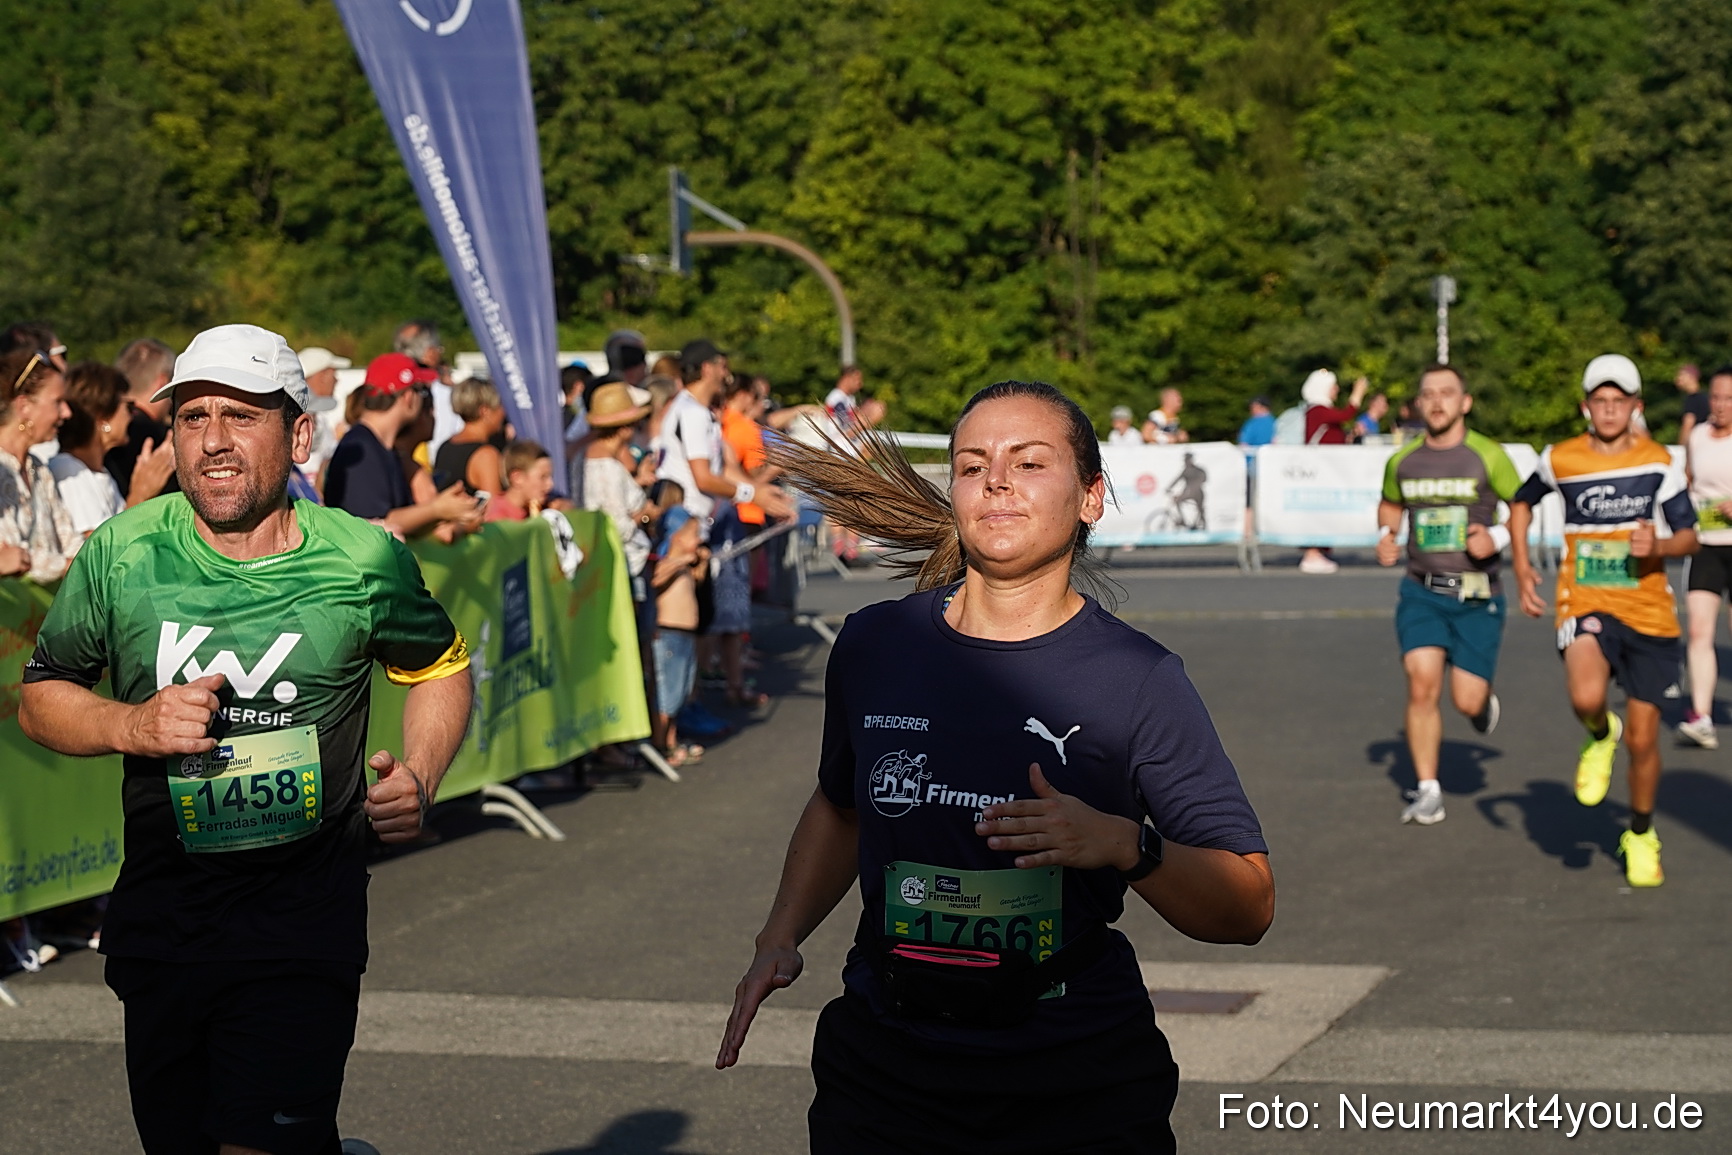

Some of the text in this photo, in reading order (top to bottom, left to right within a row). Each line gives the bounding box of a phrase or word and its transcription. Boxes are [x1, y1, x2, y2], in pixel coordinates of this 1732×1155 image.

[213, 706, 293, 727] NERGIE
[871, 715, 930, 732] PFLEIDERER
[206, 755, 252, 772] Firmenlauf
[225, 764, 253, 773] neumarkt
[197, 769, 300, 816] 1458
[302, 770, 317, 821] 2022
[181, 795, 199, 832] RUN
[199, 806, 305, 832] Ferradas Miguel
[928, 891, 982, 904] Firmenlauf
[914, 911, 1034, 955] 1766
